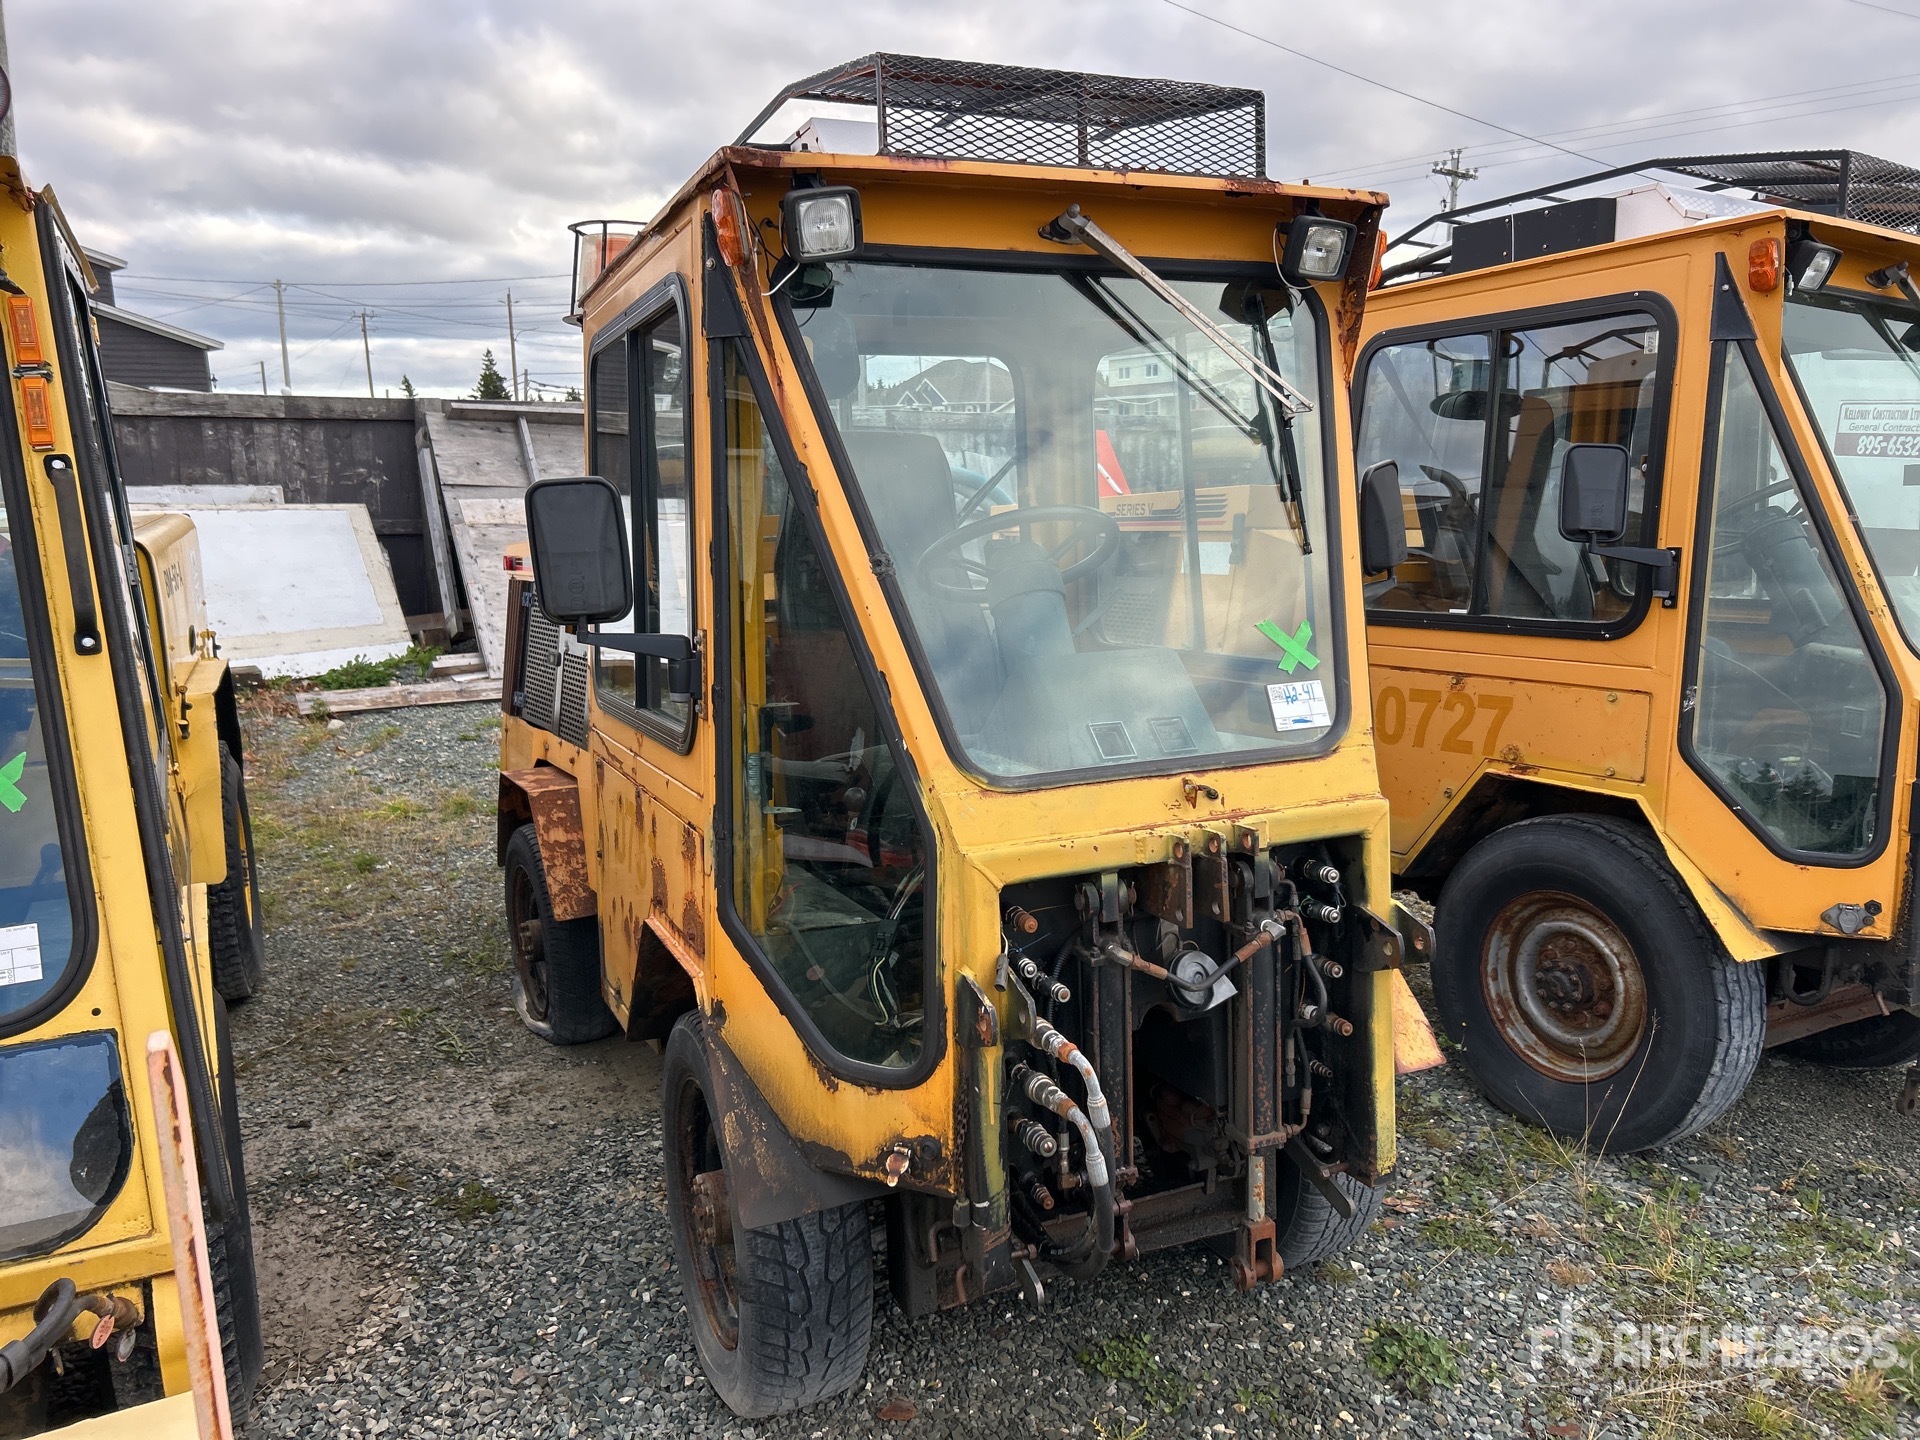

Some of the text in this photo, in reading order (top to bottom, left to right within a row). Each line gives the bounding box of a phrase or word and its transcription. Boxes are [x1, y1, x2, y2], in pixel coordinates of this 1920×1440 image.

[1872, 407, 1909, 420] CONSTRUCTION
[1856, 435, 1920, 456] 895-6532
[1116, 504, 1146, 516] SERIES
[1375, 686, 1513, 756] 0727
